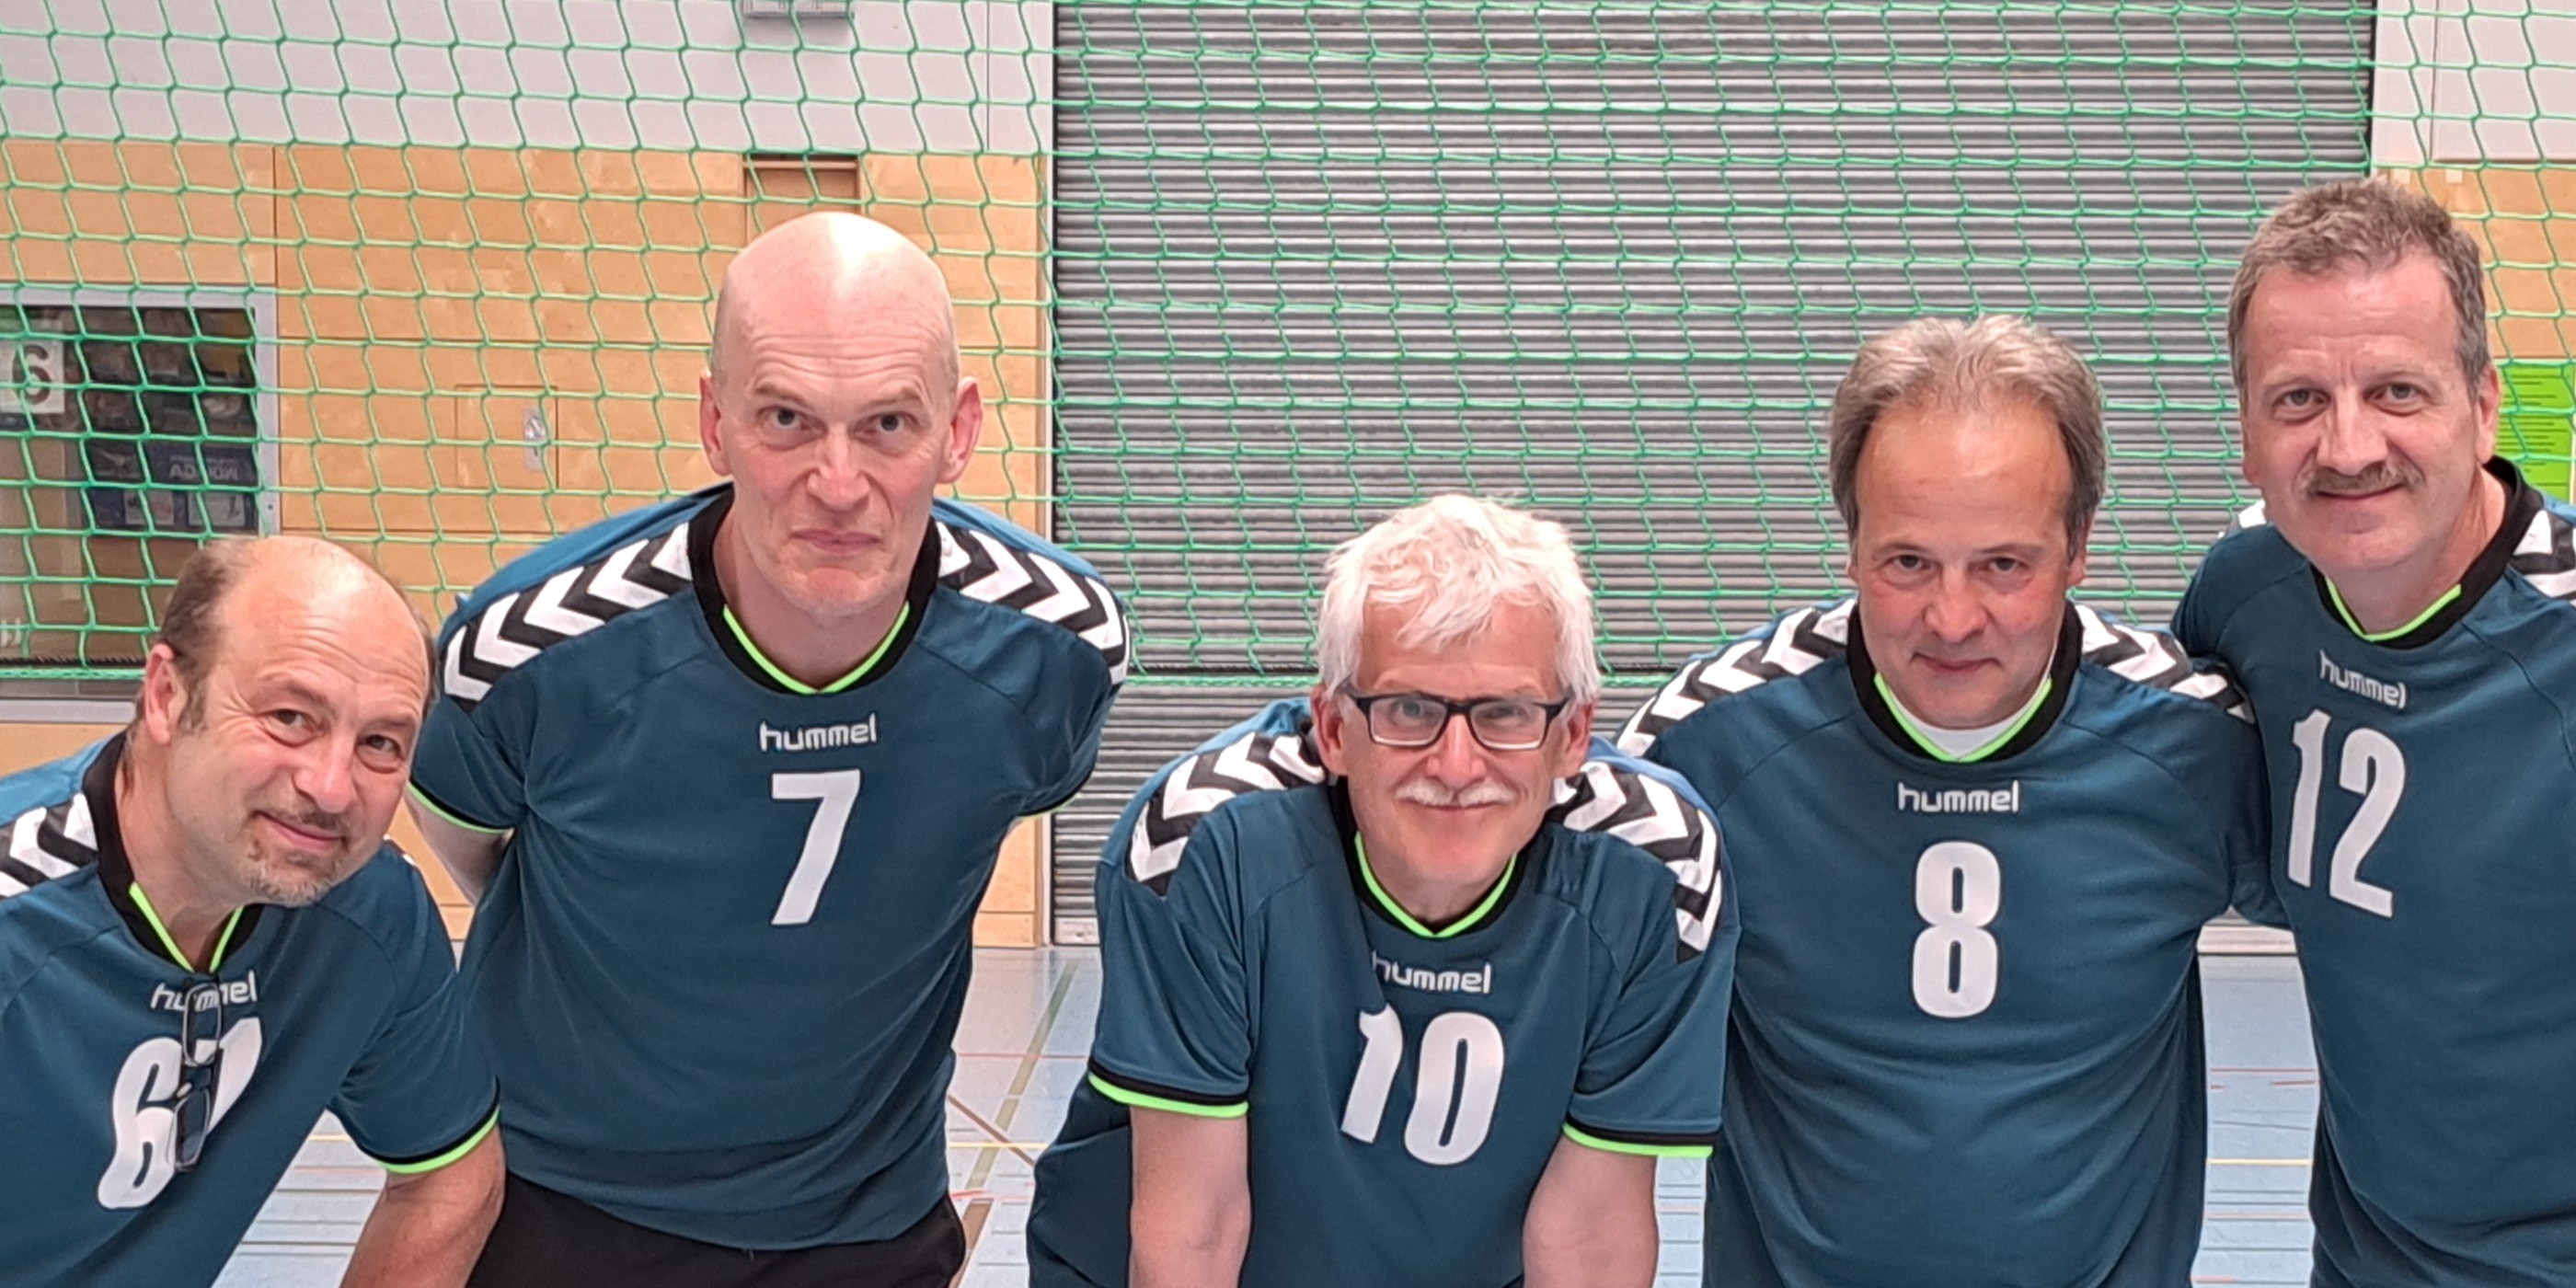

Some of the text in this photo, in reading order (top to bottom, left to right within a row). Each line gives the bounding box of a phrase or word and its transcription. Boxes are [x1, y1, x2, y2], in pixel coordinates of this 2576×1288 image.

[759, 712, 877, 752] hummel
[2319, 650, 2407, 708] hummel
[771, 768, 861, 926] 7
[1898, 779, 2019, 812] hummel
[2288, 708, 2405, 919] 12
[1371, 949, 1492, 995] hummel
[1912, 841, 2001, 1018] 8
[1340, 1003, 1504, 1165] 10
